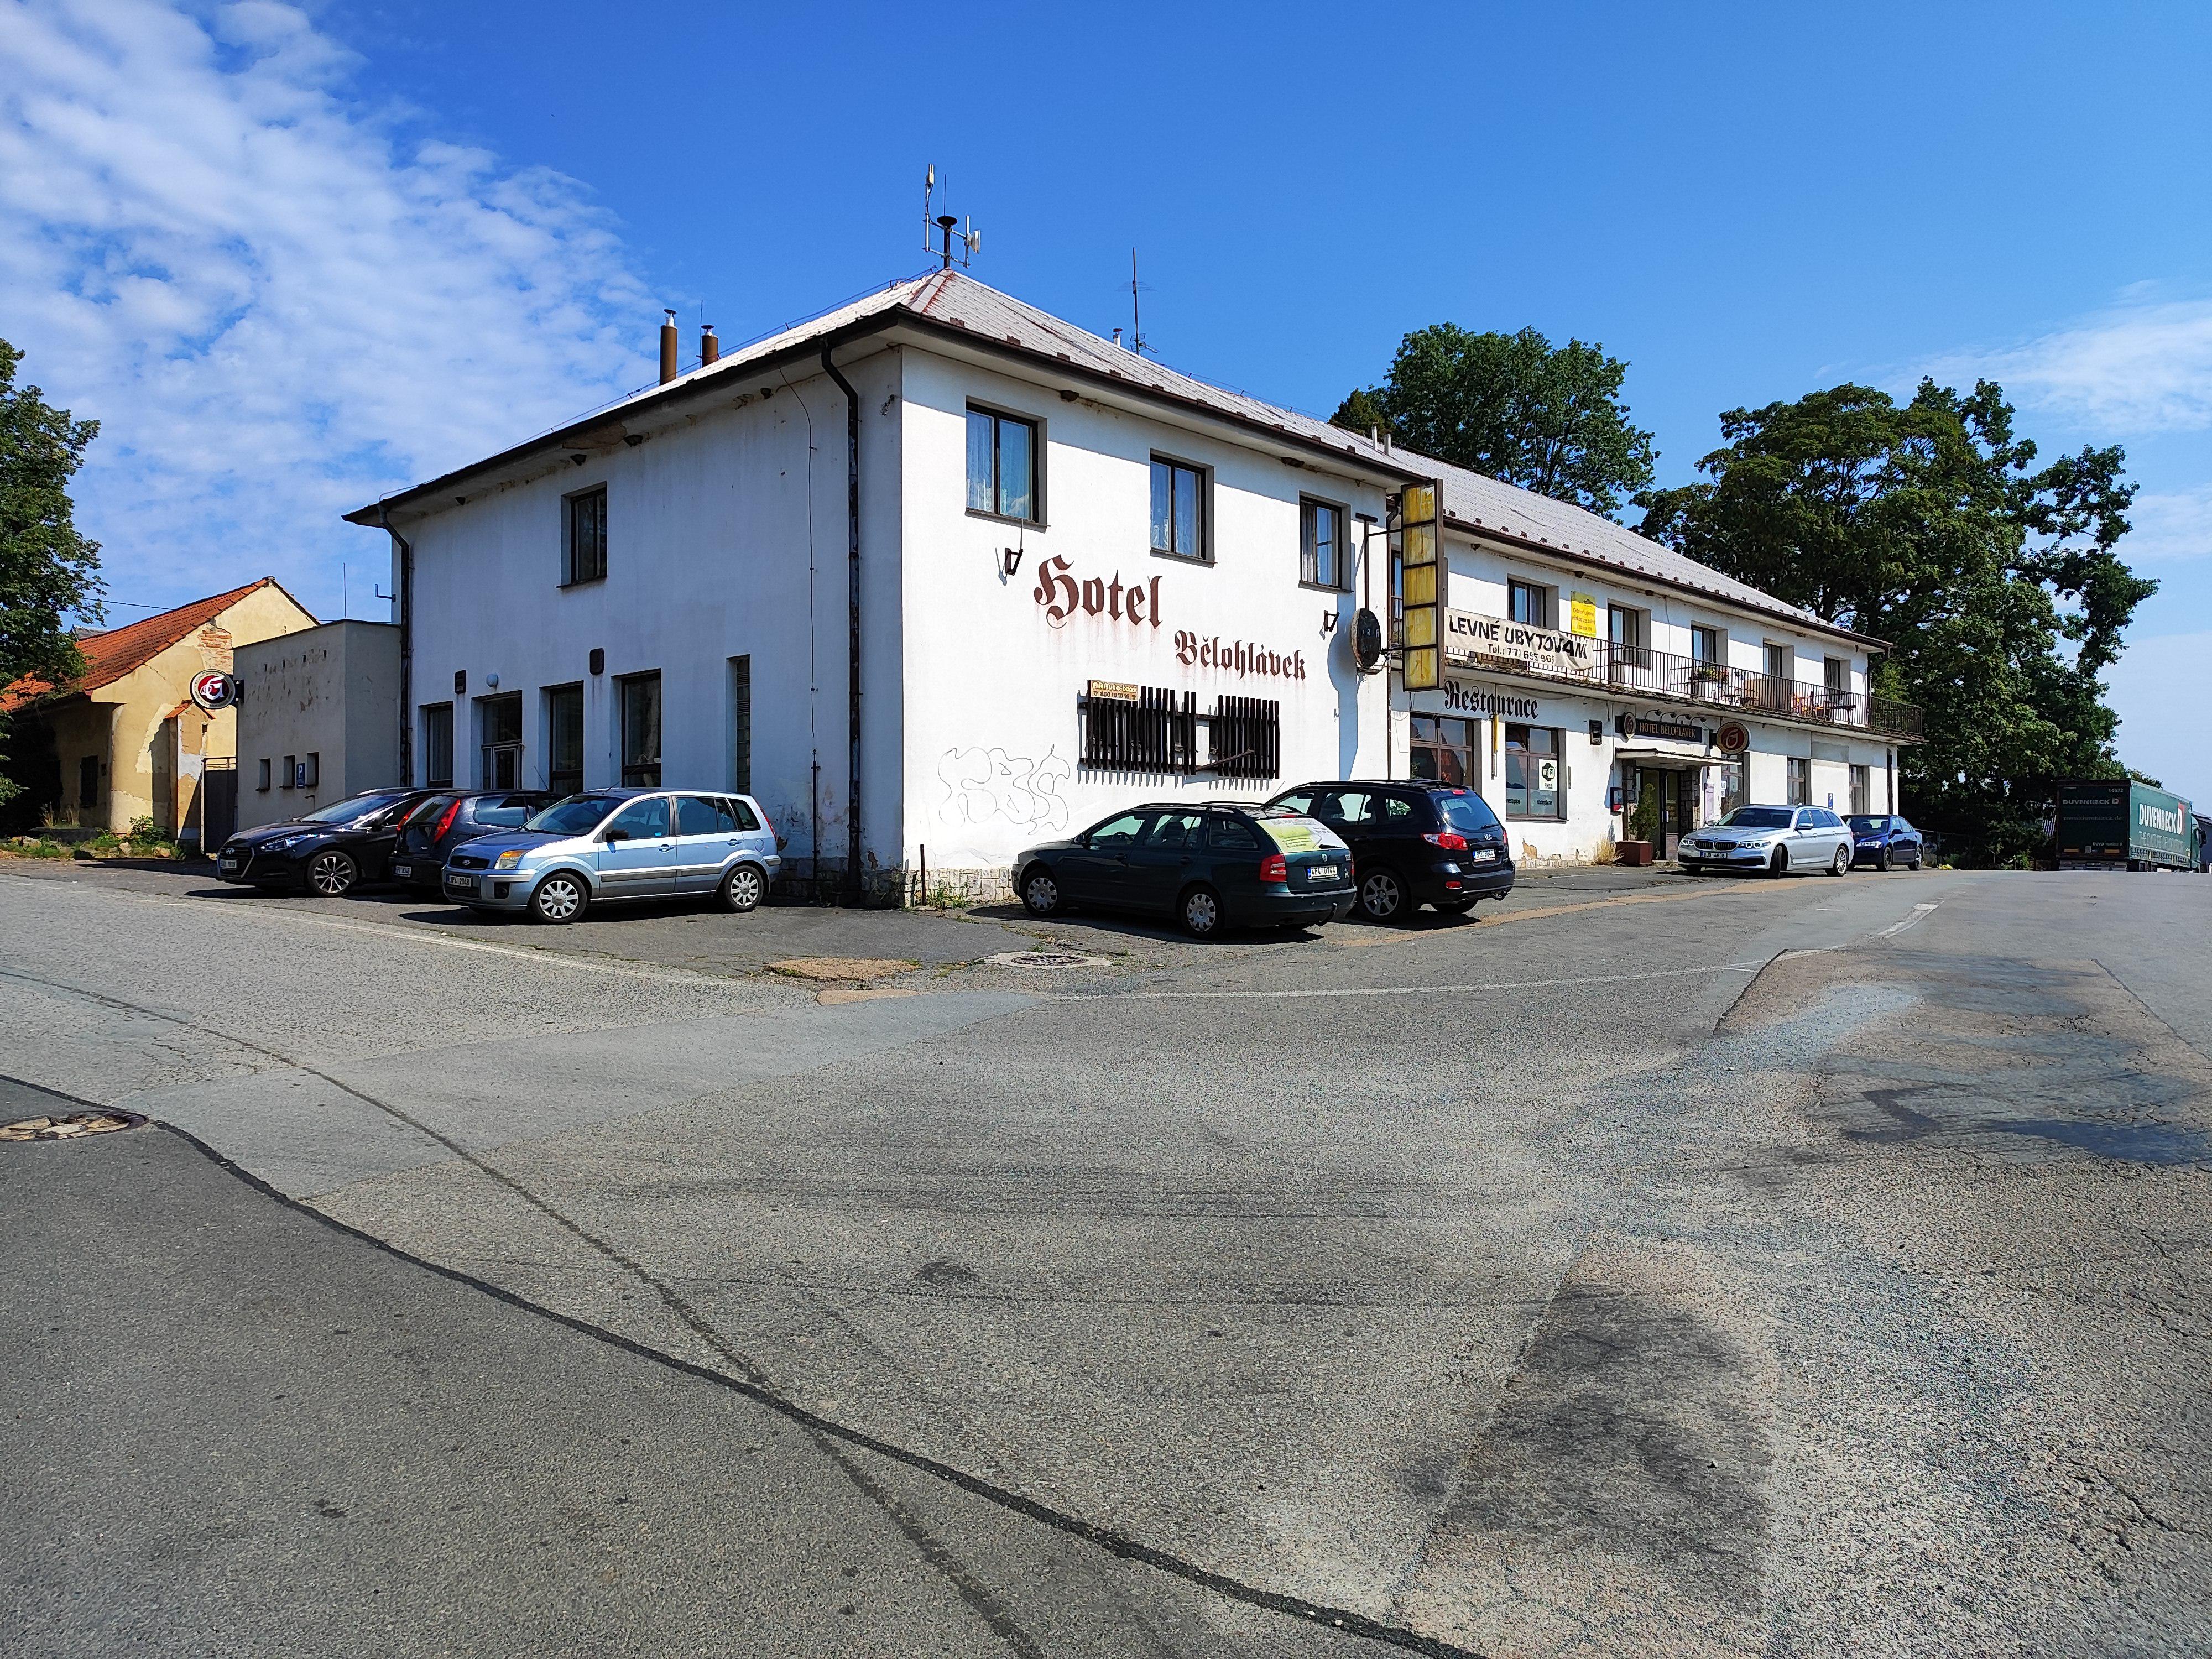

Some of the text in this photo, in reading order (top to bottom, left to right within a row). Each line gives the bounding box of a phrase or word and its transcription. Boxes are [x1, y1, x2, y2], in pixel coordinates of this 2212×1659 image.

[1034, 554, 1164, 629] Hotel
[1448, 615, 1500, 641] LEVNÉ
[1174, 630, 1306, 681] Bělohlávek
[1444, 680, 1538, 720] Restaurace
[1639, 722, 1659, 734] HOTEL
[2138, 803, 2177, 833] DUVENBECK
